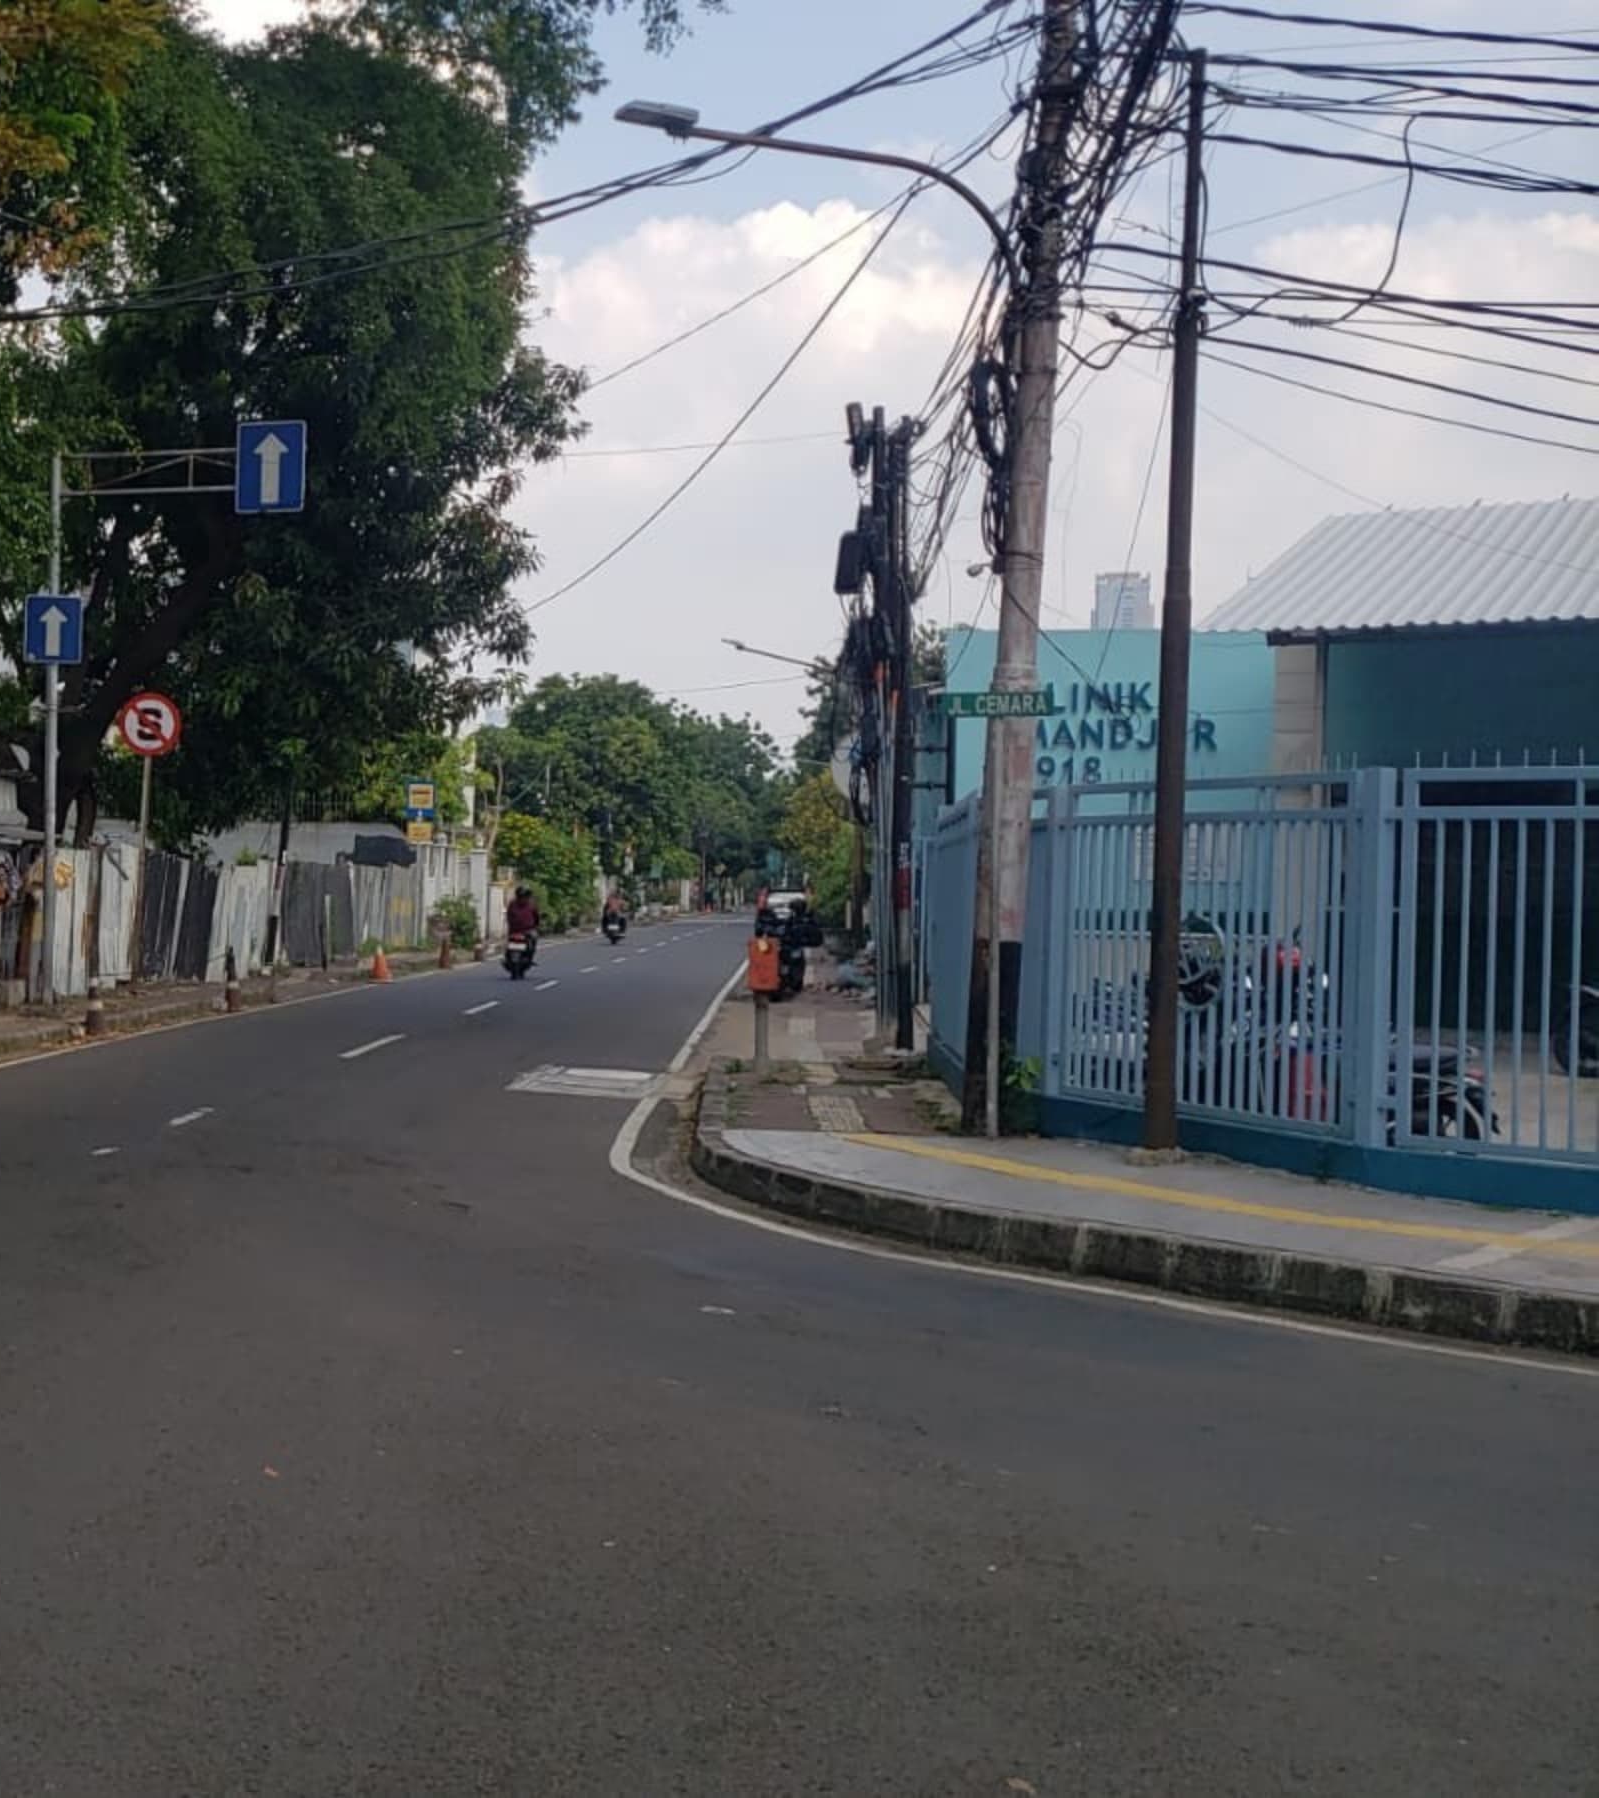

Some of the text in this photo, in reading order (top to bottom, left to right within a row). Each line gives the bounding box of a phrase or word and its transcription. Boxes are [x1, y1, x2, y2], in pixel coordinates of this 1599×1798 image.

[975, 694, 1047, 714] CEMARA
[1046, 682, 1154, 714] LINIK
[137, 707, 163, 741] S
[1035, 719, 1217, 751] ANDJR
